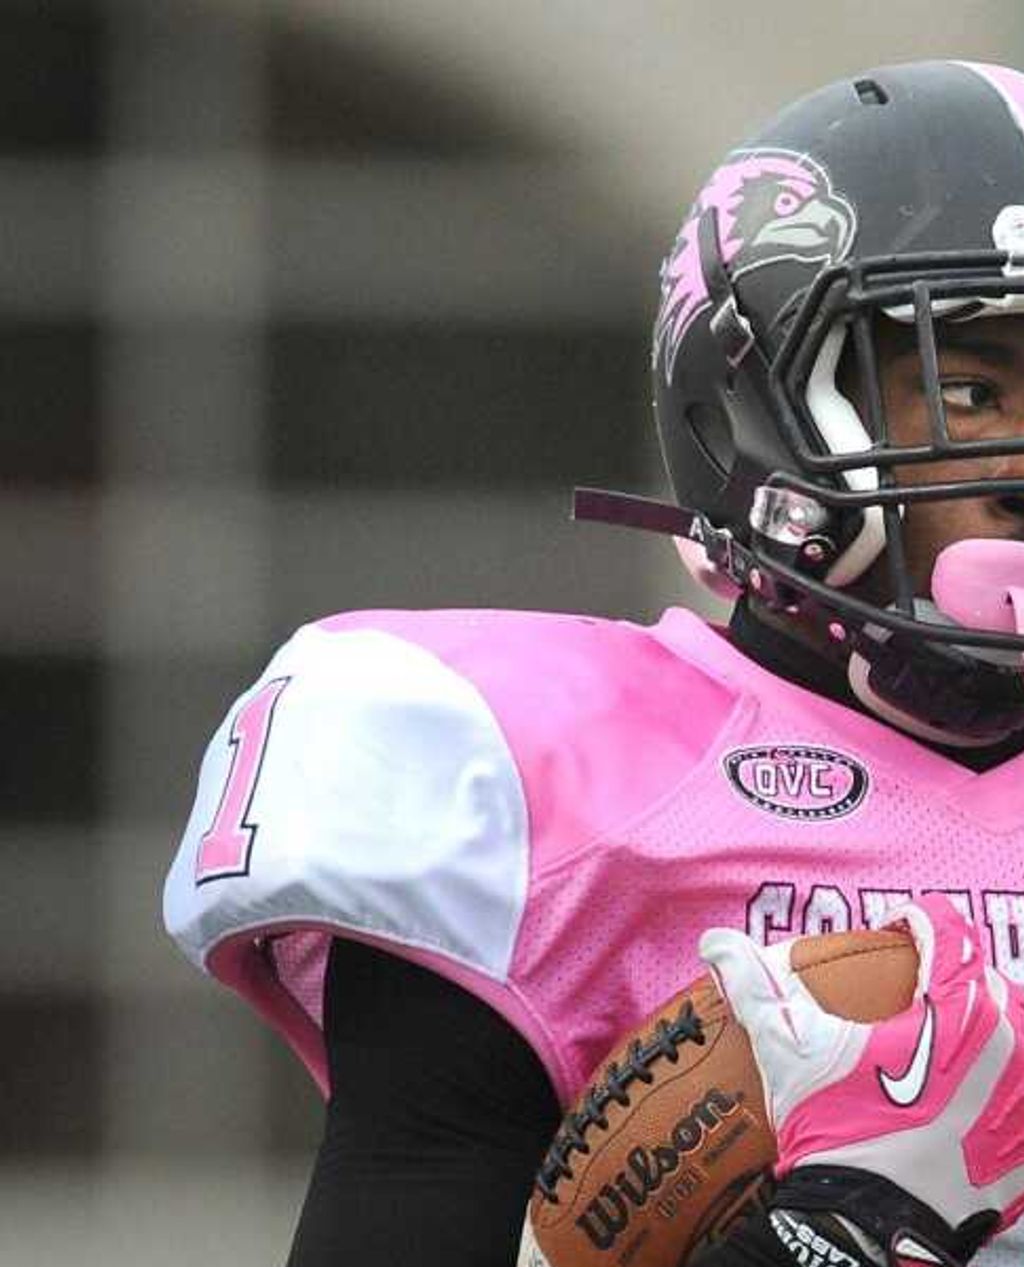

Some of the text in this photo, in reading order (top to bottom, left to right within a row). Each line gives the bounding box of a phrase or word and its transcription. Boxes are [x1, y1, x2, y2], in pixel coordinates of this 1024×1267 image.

[195, 675, 293, 887] 1
[753, 762, 835, 799] OVC
[575, 1087, 746, 1250] Wilson
